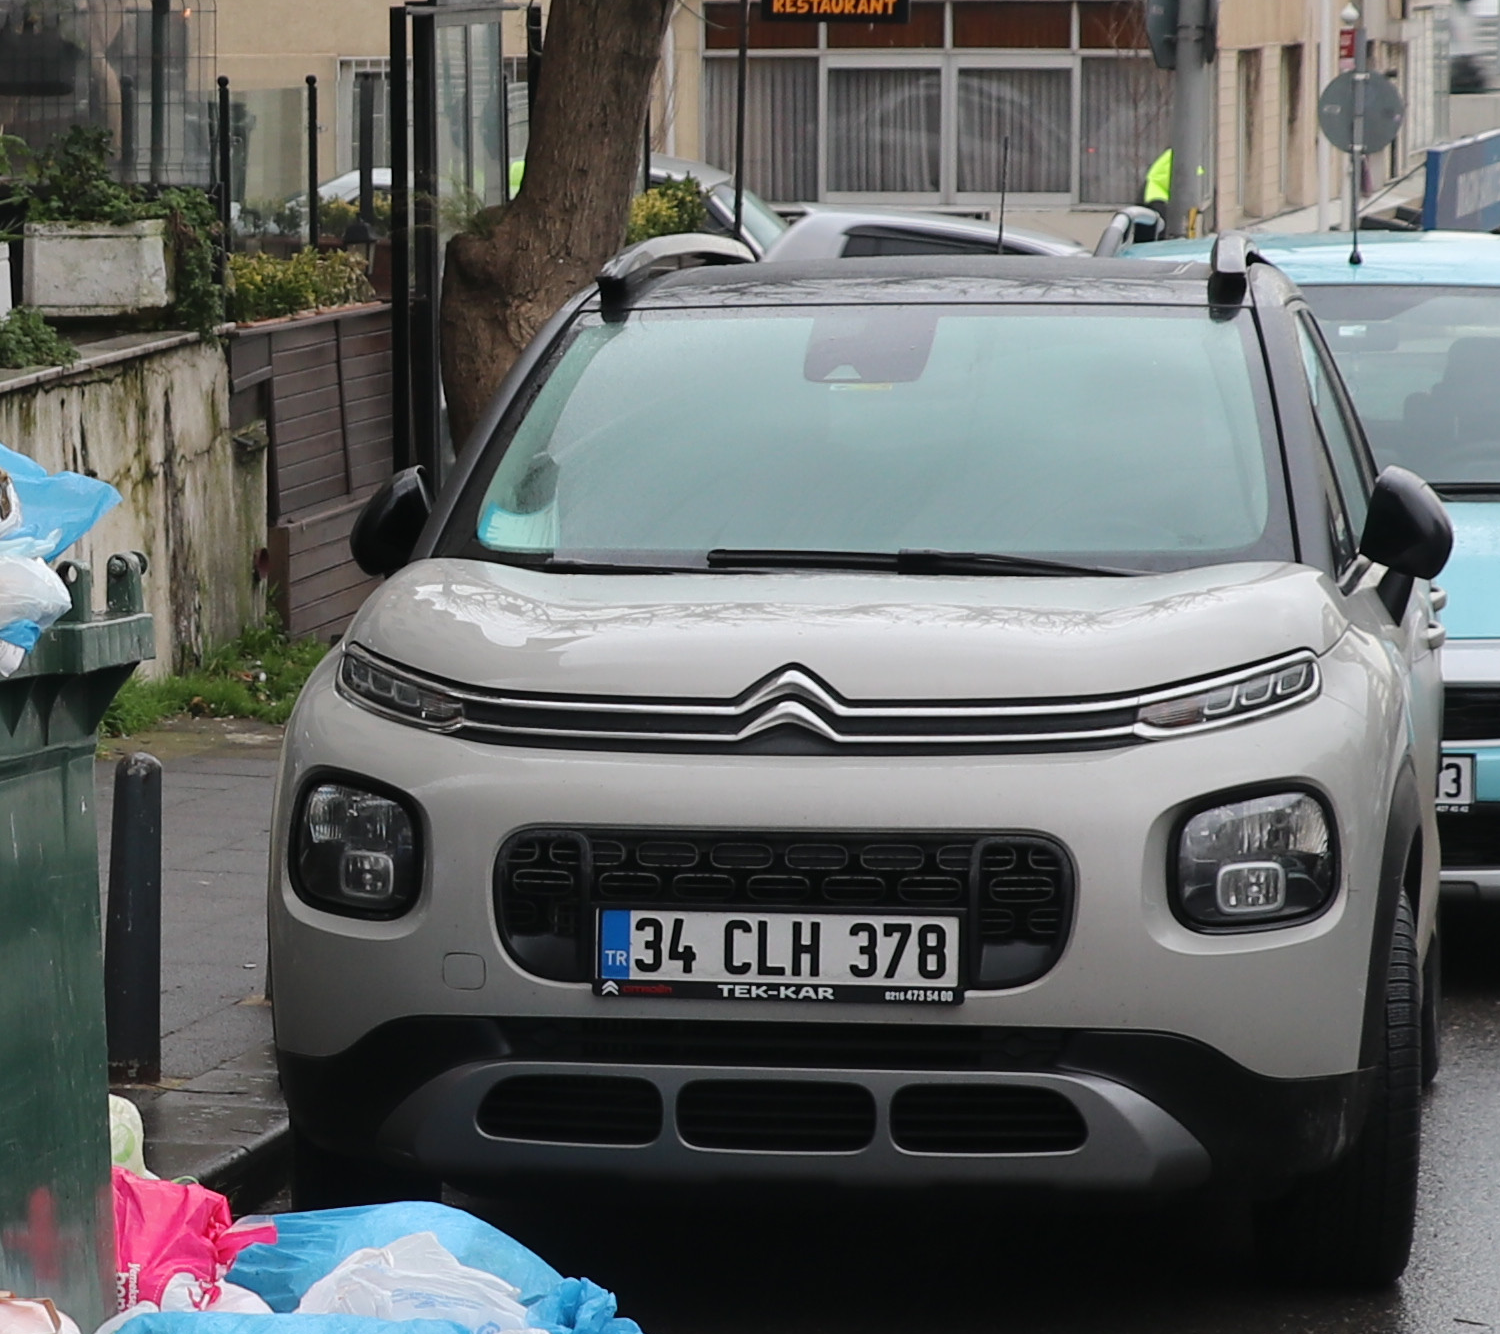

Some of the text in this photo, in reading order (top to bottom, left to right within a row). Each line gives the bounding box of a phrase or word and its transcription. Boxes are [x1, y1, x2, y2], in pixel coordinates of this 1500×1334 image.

[634, 917, 947, 980] 34 CLH 378
[605, 950, 627, 966] TR
[717, 984, 835, 1000] TEK-KAR
[905, 989, 925, 1001] 473
[926, 990, 939, 1002] 54
